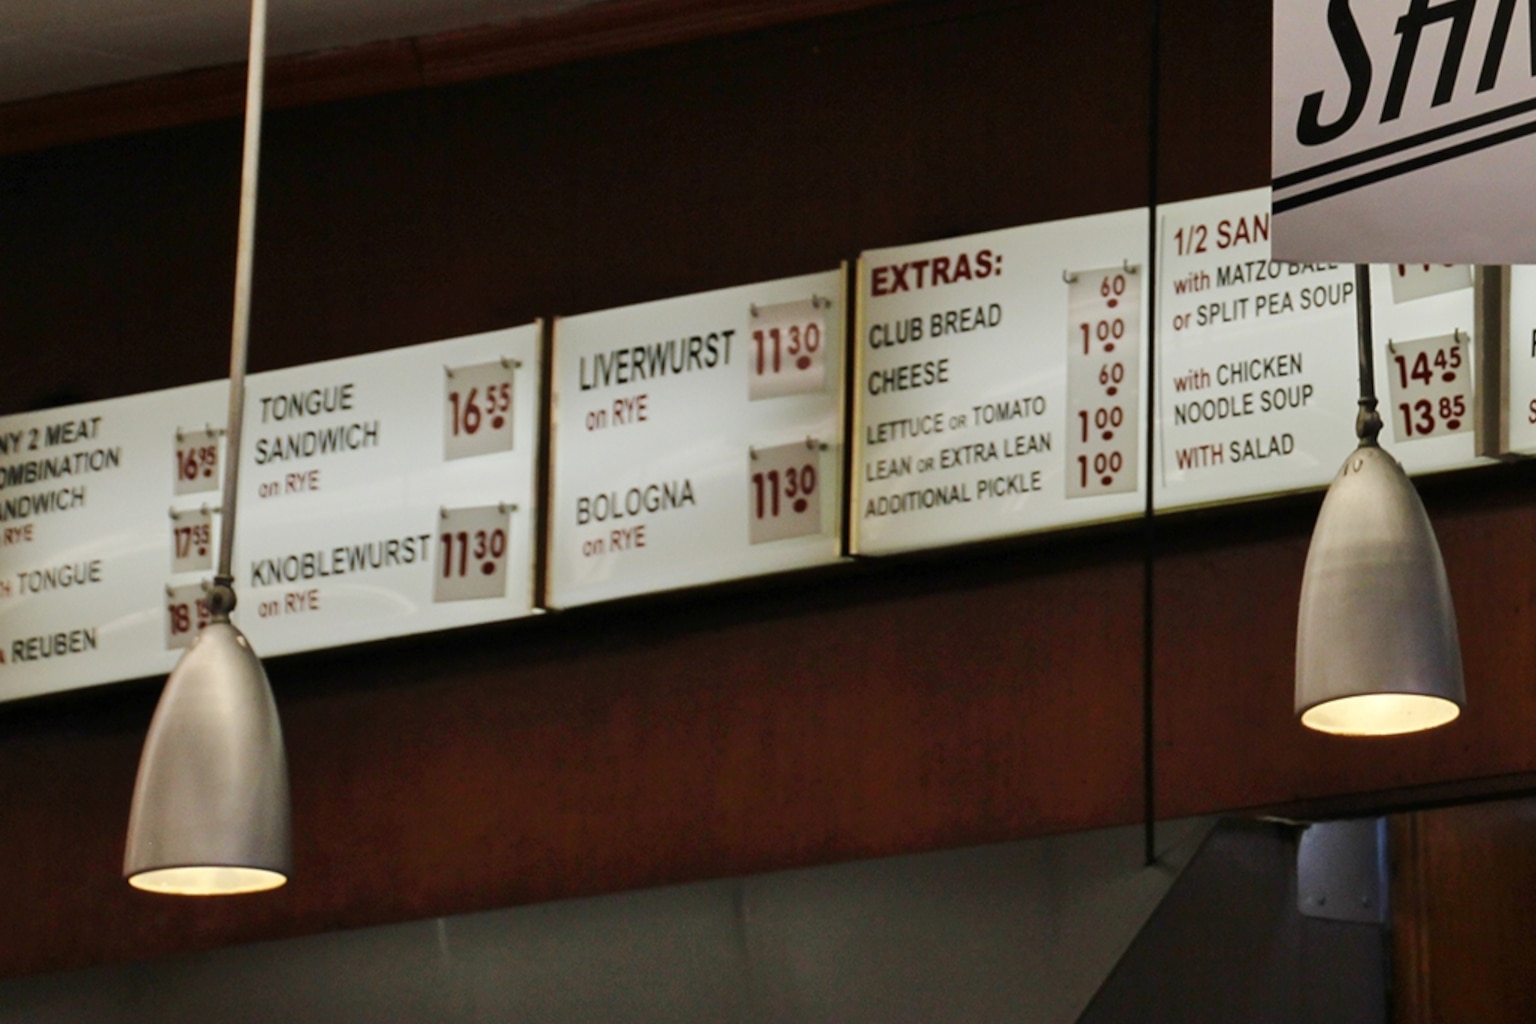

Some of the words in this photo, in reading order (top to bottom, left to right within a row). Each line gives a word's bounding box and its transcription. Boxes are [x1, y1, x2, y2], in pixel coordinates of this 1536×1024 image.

[1174, 224, 1208, 256] 1/2
[870, 249, 1003, 298] EXTRAS:
[1173, 271, 1211, 295] with
[1216, 259, 1281, 287] MATZO
[869, 316, 923, 349] CLUB
[930, 303, 1002, 337] BREAD
[1173, 312, 1191, 331] or
[1197, 298, 1249, 326] SPLIT
[1256, 291, 1294, 317] PEA
[1300, 282, 1354, 310] SOUP
[579, 329, 735, 391] LIVERWURST
[868, 358, 949, 396] CHEESE
[1174, 368, 1211, 393] with
[1216, 352, 1303, 387] CHICKEN
[259, 383, 355, 423] TONGUE
[586, 409, 607, 431] on
[612, 394, 648, 425] RYE
[866, 413, 944, 446] LETTUCE
[972, 396, 1046, 426] TOMATO
[1174, 392, 1254, 426] NOODLE
[1261, 384, 1314, 412] SOUP
[28, 428, 39, 450] 2
[45, 417, 102, 447] MEAT
[255, 420, 379, 465] SANDWICH
[1176, 443, 1224, 471] WITH
[1229, 432, 1295, 464] SALAD
[865, 455, 912, 482] LEAN
[940, 441, 998, 469] EXTRA
[1004, 432, 1052, 459] LEAN
[258, 478, 281, 499] on
[285, 470, 320, 495] RYE
[576, 478, 696, 525] BOLOGNA
[864, 486, 971, 519] ADDITIONAL
[977, 471, 1042, 500] PICKLE
[4, 524, 34, 545] RYE
[582, 538, 604, 557] on
[610, 525, 646, 552] RYE
[17, 560, 102, 594] TONGUE
[250, 534, 432, 587] KNOBLEWURST
[258, 598, 281, 619] on
[285, 589, 320, 613] RYE
[12, 628, 97, 664] REUBEN
